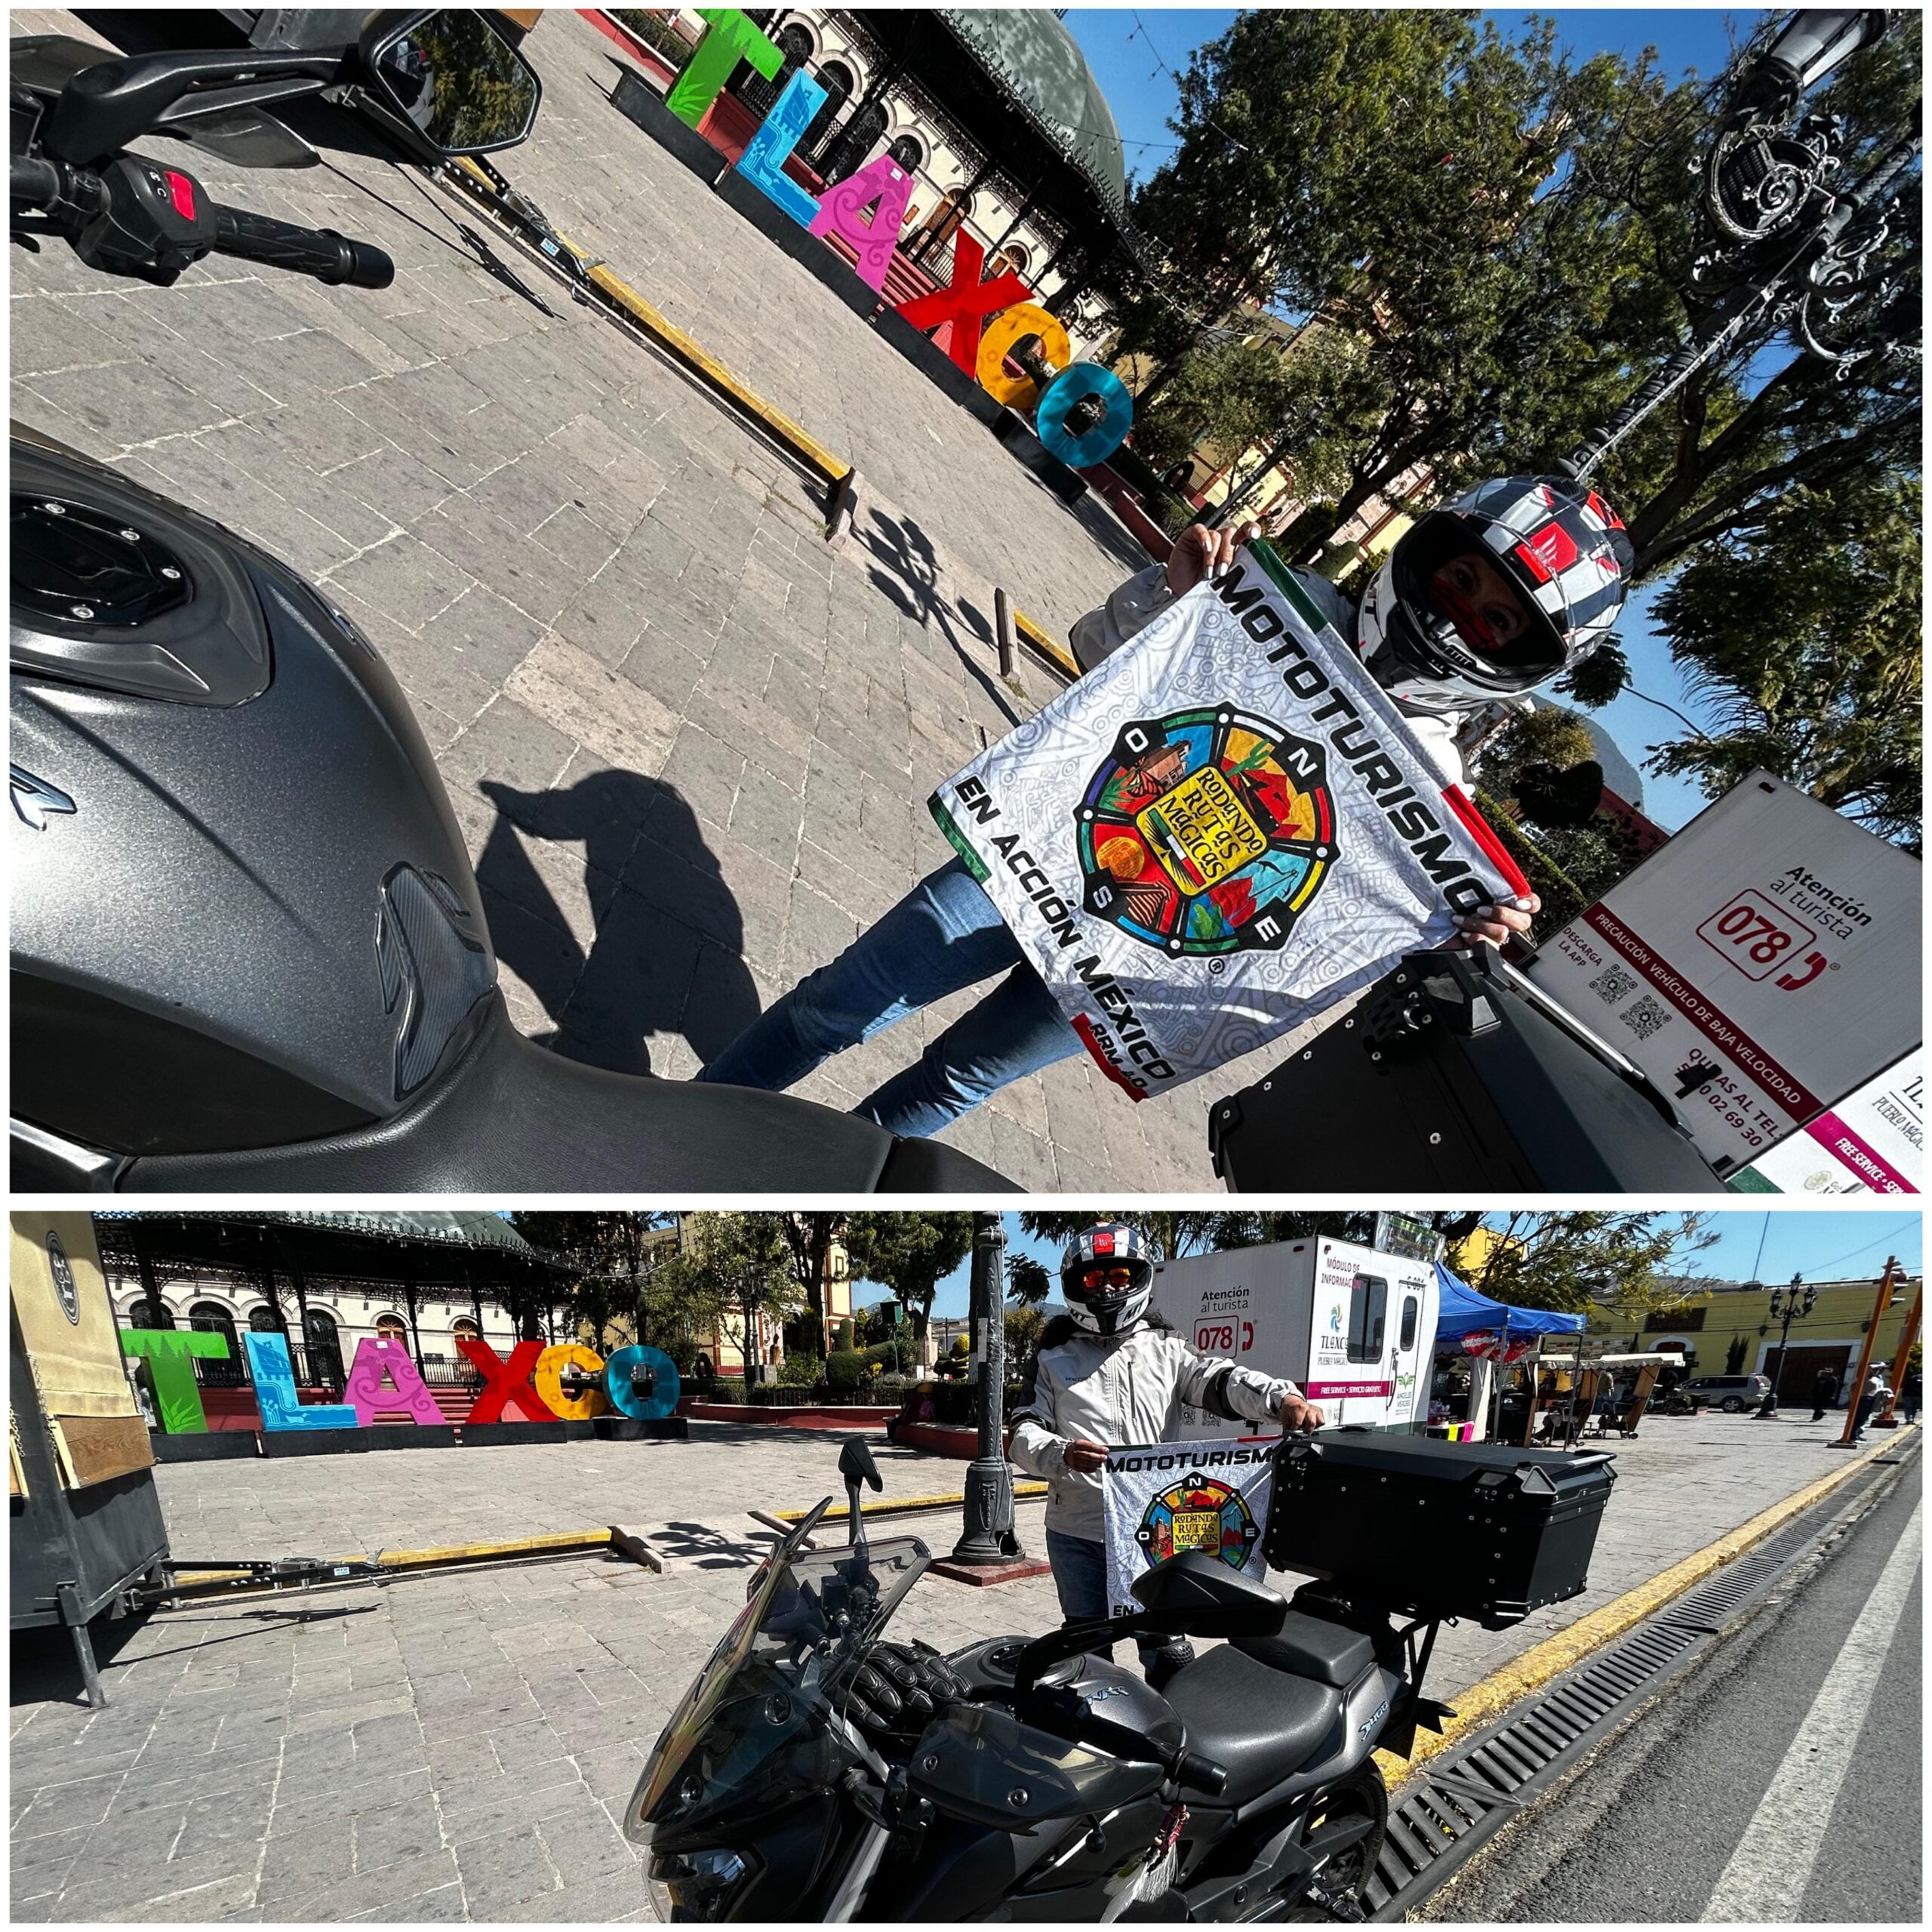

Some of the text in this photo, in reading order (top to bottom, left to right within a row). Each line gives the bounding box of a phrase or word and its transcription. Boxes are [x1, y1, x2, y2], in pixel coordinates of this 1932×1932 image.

[664, 9, 1134, 467] TLAXCO
[1211, 565, 1494, 914] MOTOTURISMO
[1287, 747, 1318, 777] N
[1094, 886, 1113, 908] S
[1770, 878, 1854, 940] al turista
[1786, 866, 1872, 927] Atención
[955, 776, 1176, 1079] EN ACCIÓN MÉXICO
[1254, 915, 1281, 942] E
[1563, 927, 1603, 967] DESCARGA
[1717, 906, 1792, 964] 078
[1558, 940, 1586, 967] LA APP
[1595, 914, 1801, 1103] PRECAUCIÓN VEHÍCULO DE BAJA VELOCIDAD
[1089, 1023, 1124, 1065] RRM
[1689, 1048, 1738, 1094] QUAS
[1732, 1094, 1753, 1112] AL
[1709, 1095, 1728, 1112] 02
[1724, 1111, 1745, 1128] 69
[1740, 1128, 1763, 1146] 30
[1835, 1137, 1859, 1157] FREE
[1851, 1152, 1886, 1181] SERVICE
[1321, 1273, 1361, 1289] INFORMAC
[1327, 1257, 1352, 1272] MÓDULO
[1201, 1285, 1250, 1301] Atención
[1201, 1299, 1248, 1312] al turista
[1069, 1308, 1087, 1322] MT
[1198, 1326, 1232, 1351] 078
[121, 1329, 679, 1435] TLAXCO
[1189, 1478, 1201, 1486] N
[1113, 1605, 1134, 1617] EN
